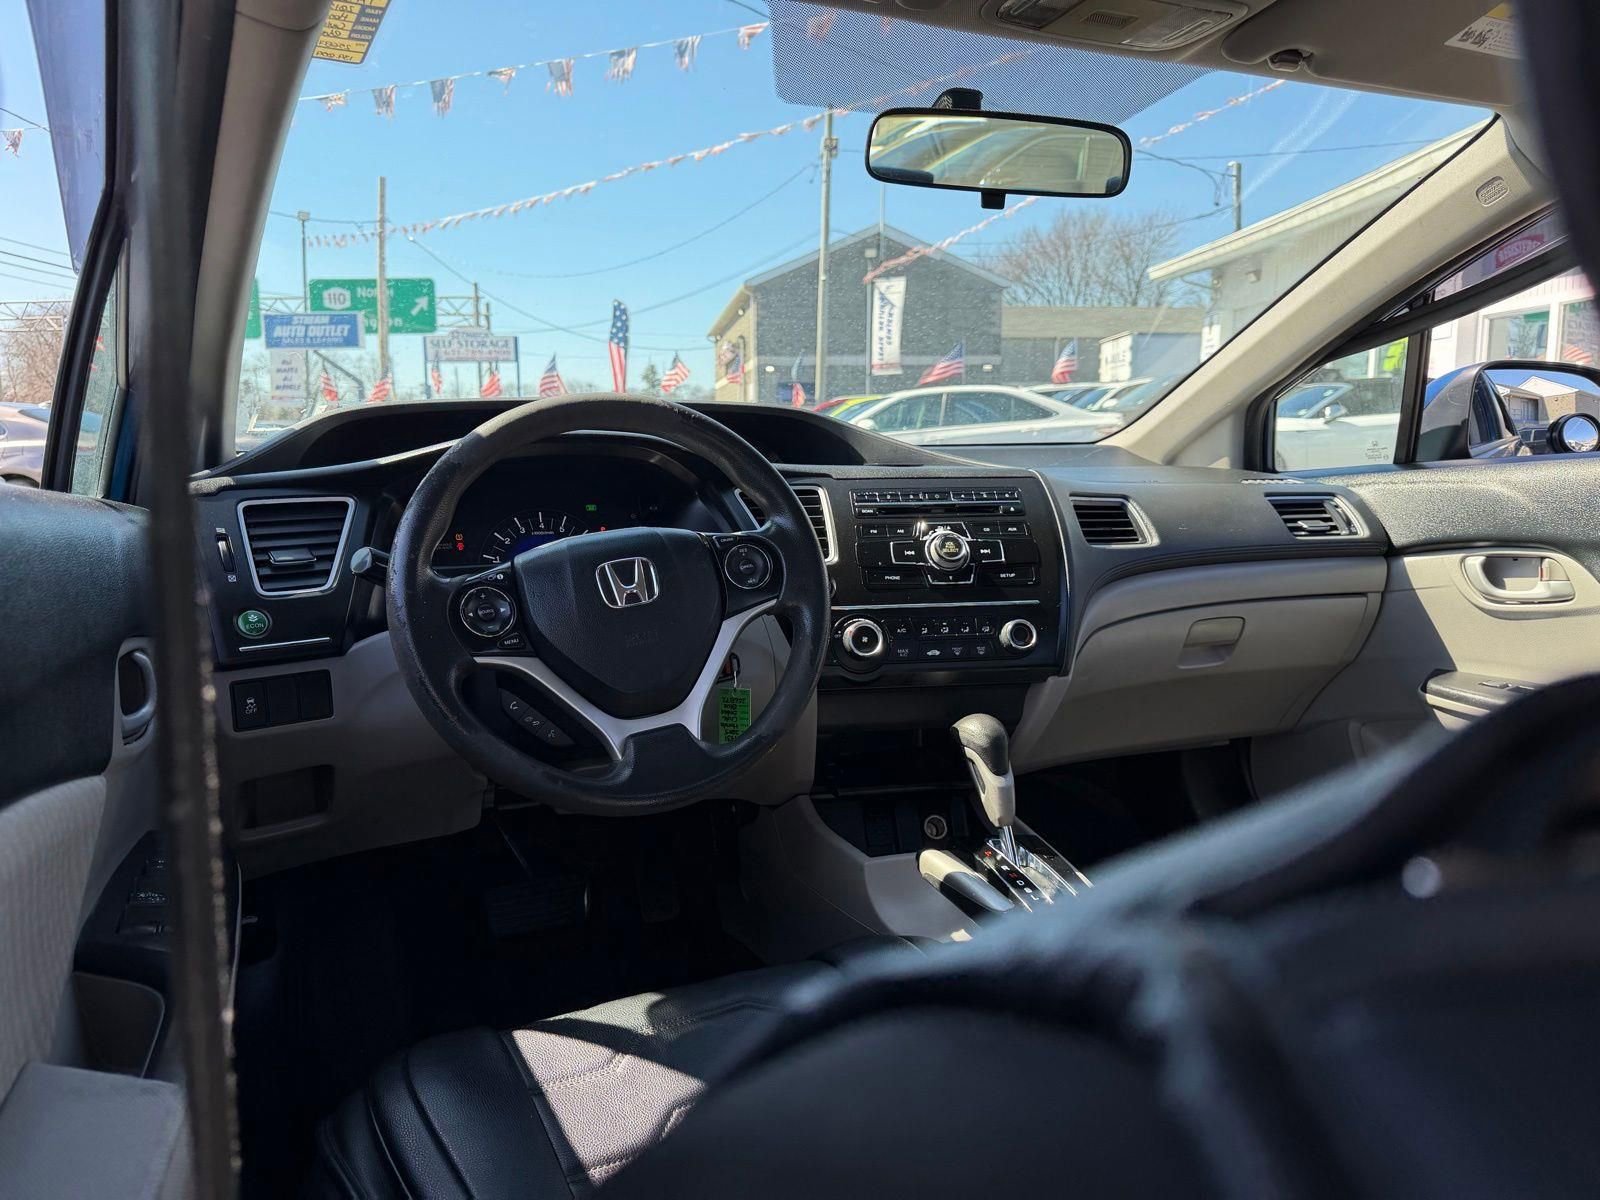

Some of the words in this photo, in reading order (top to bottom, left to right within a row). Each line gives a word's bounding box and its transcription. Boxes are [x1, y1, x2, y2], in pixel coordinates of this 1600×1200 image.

[326, 292, 346, 306] 110
[273, 325, 306, 337] AUTO
[307, 325, 350, 337] OUTLET
[457, 339, 510, 348] STORAGE
[519, 526, 526, 534] 3
